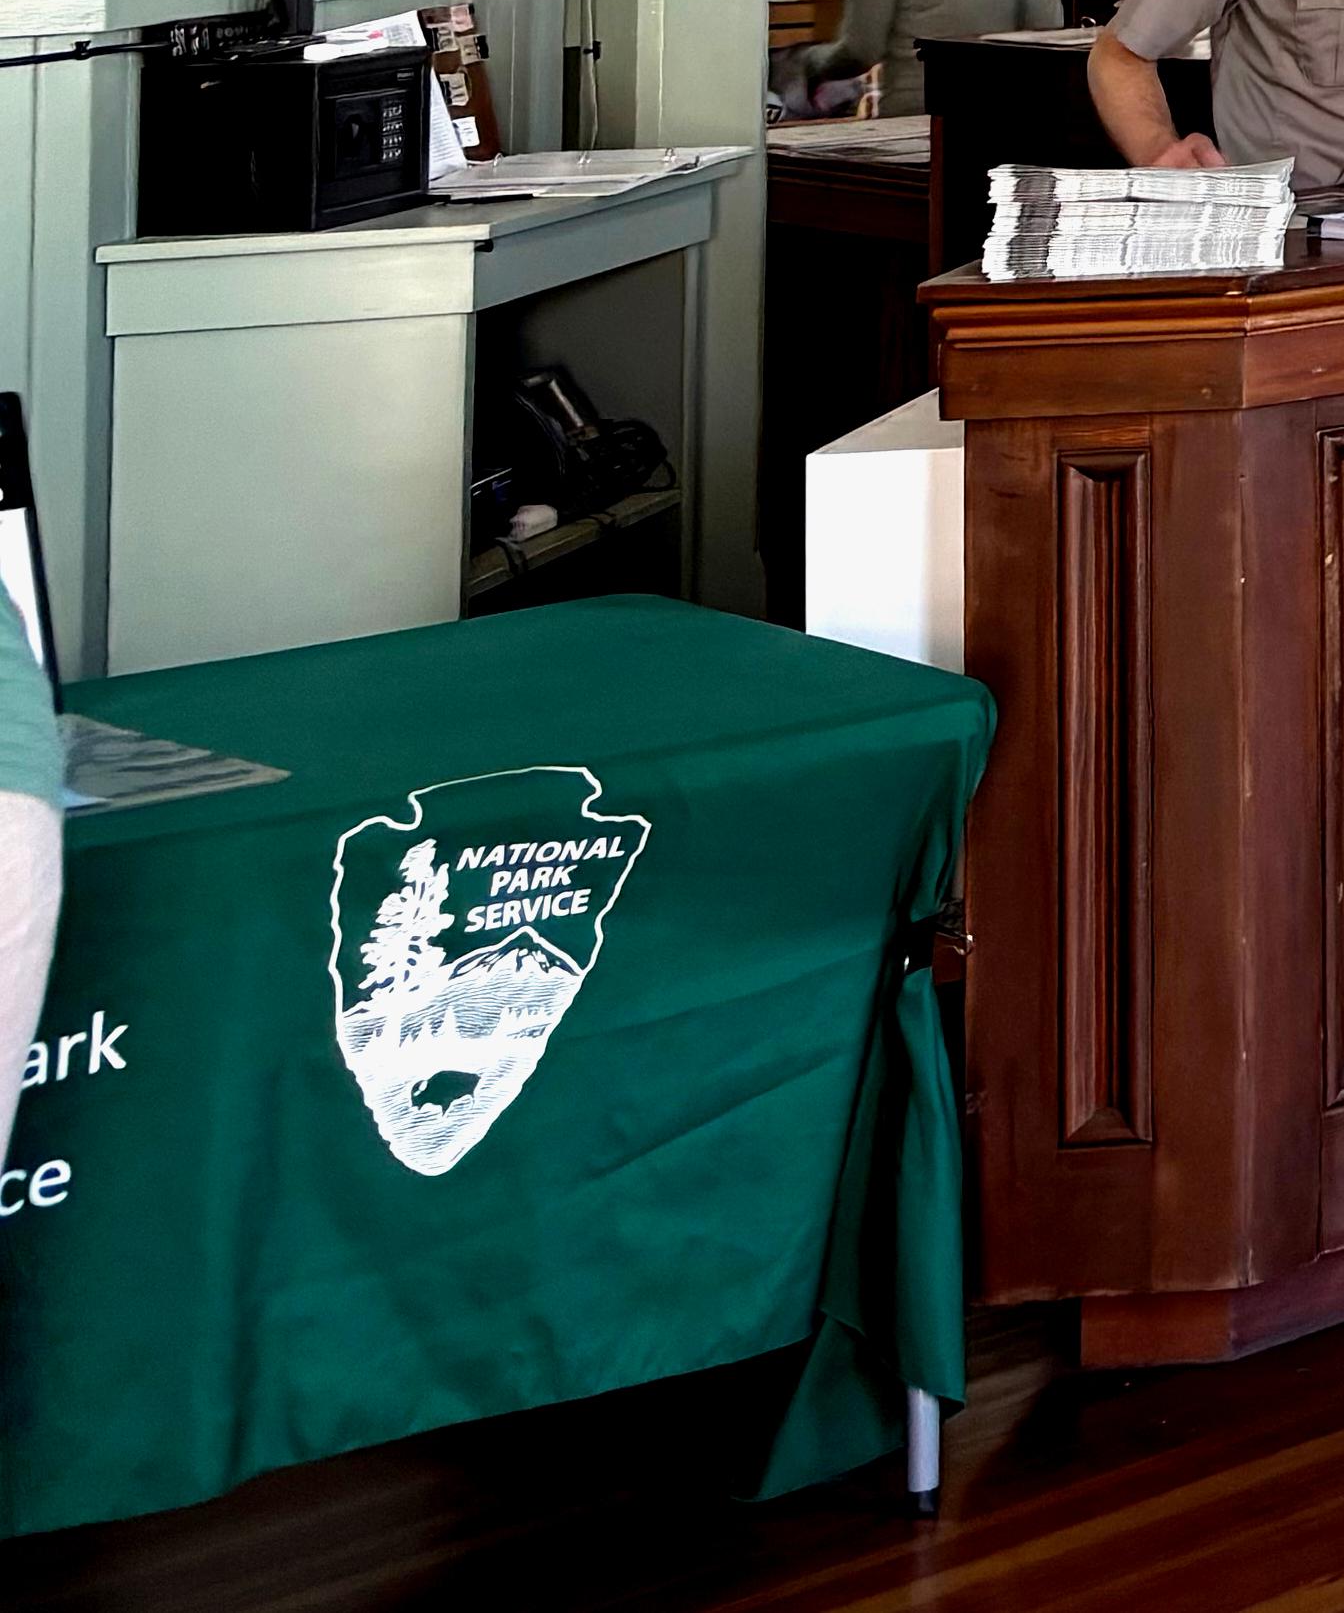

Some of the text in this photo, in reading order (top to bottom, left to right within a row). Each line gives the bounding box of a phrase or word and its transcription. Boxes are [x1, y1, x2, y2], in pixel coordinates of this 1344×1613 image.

[456, 835, 626, 872] NATIONAL
[490, 863, 574, 897] PARK
[465, 888, 592, 933] SERVICE
